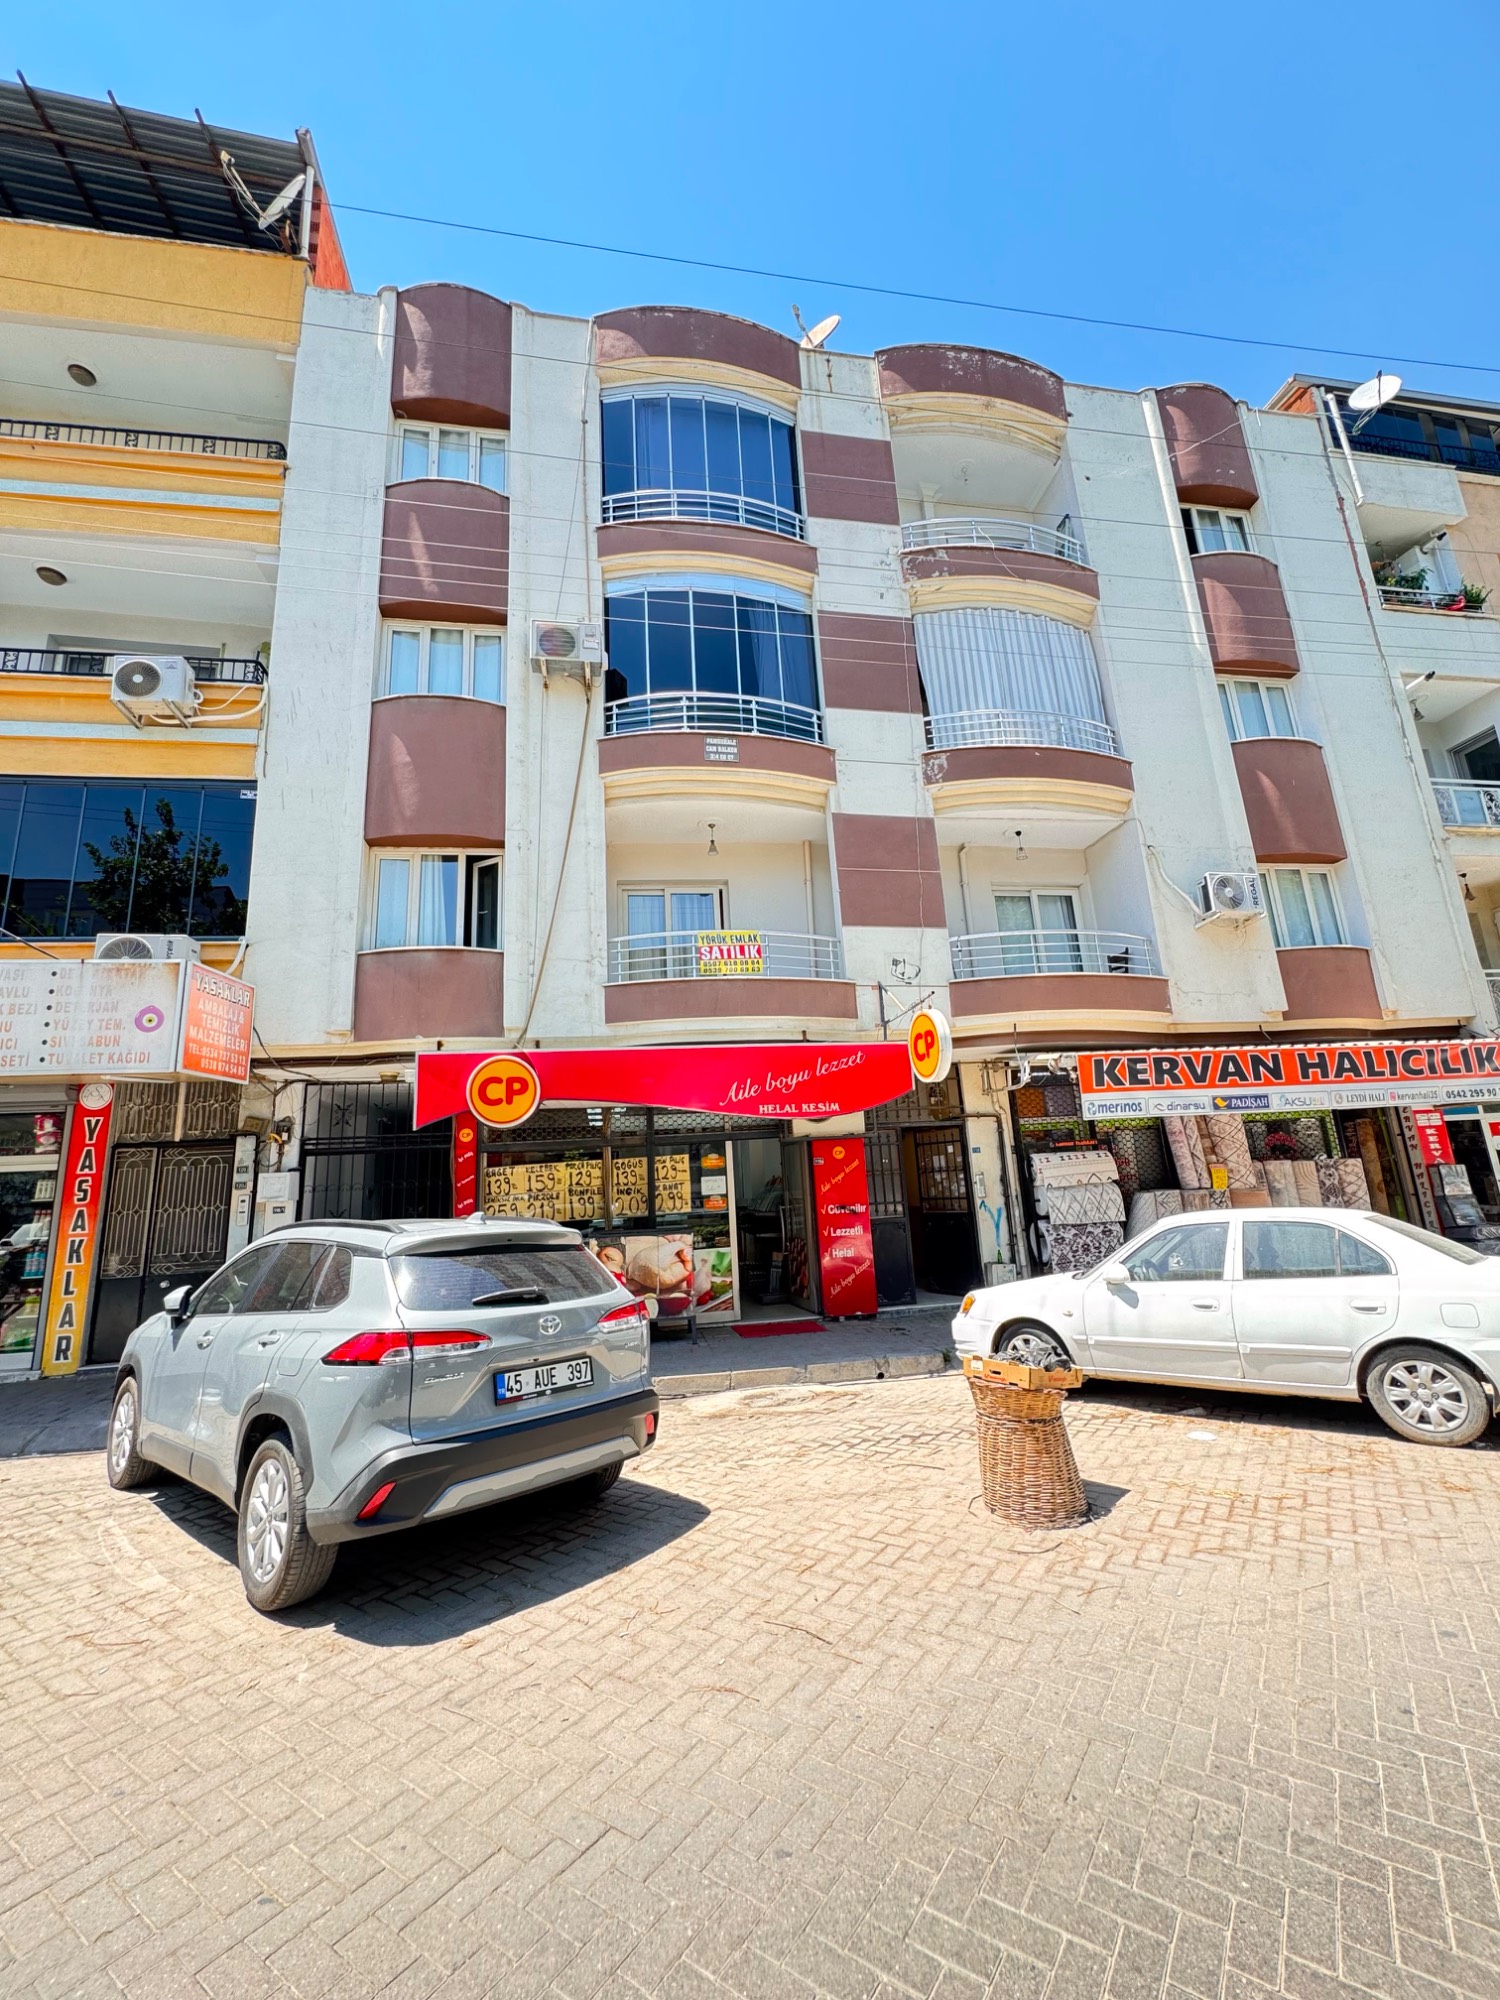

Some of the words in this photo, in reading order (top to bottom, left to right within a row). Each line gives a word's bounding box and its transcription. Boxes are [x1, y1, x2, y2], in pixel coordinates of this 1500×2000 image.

[1248, 877, 1260, 906] REGAL
[700, 934, 728, 945] YÖRÜK
[729, 933, 759, 944] EMLAK
[700, 945, 760, 960] SATILIK
[195, 971, 250, 1009] YASAKLAR
[8, 1001, 38, 1016] BEZİ
[197, 999, 238, 1022] AMBALAJ
[238, 1012, 245, 1025] &
[98, 1018, 126, 1031] TEM.
[201, 1014, 240, 1037] TEMİZLİK
[188, 1025, 248, 1053] MALZEMELERİ
[913, 1029, 936, 1062] CP
[107, 1049, 151, 1065] KAĞIDI
[1092, 1051, 1287, 1090] KERVAN
[1295, 1044, 1500, 1083] HALICILIK
[719, 1077, 762, 1106] Aile
[765, 1072, 812, 1094] boyu
[816, 1050, 866, 1077] lezzet
[477, 1076, 530, 1107] CP
[1098, 1100, 1144, 1114] merinos
[1166, 1100, 1206, 1111] dinarsu
[1231, 1094, 1269, 1109] PADİŞAH
[1284, 1096, 1313, 1108] AKSU
[1346, 1092, 1368, 1103] LEYDİ
[1368, 1091, 1386, 1103] HALI
[1445, 1089, 1468, 1100] 0542
[1468, 1088, 1485, 1098] 295
[1486, 1087, 1497, 1097] 90
[759, 1103, 800, 1115] HELAL
[801, 1100, 841, 1113] KESİM
[485, 1166, 516, 1179] BAGET
[613, 1160, 644, 1170] GÖĞÜS
[655, 1164, 678, 1182] 129
[486, 1176, 511, 1196] 139
[526, 1172, 556, 1193] 159
[568, 1169, 592, 1187] 129
[614, 1170, 639, 1188] 139
[654, 1182, 686, 1193] KANAT
[568, 1196, 595, 1220] 199
[614, 1195, 648, 1217] 209
[655, 1191, 685, 1213] 299
[52, 1115, 105, 1364] YASAKLAR
[830, 1225, 864, 1237] Lezzetli
[832, 1247, 855, 1258] Helal
[506, 1373, 523, 1395] 45
[534, 1366, 557, 1390] AUE
[567, 1360, 590, 1383] 397
